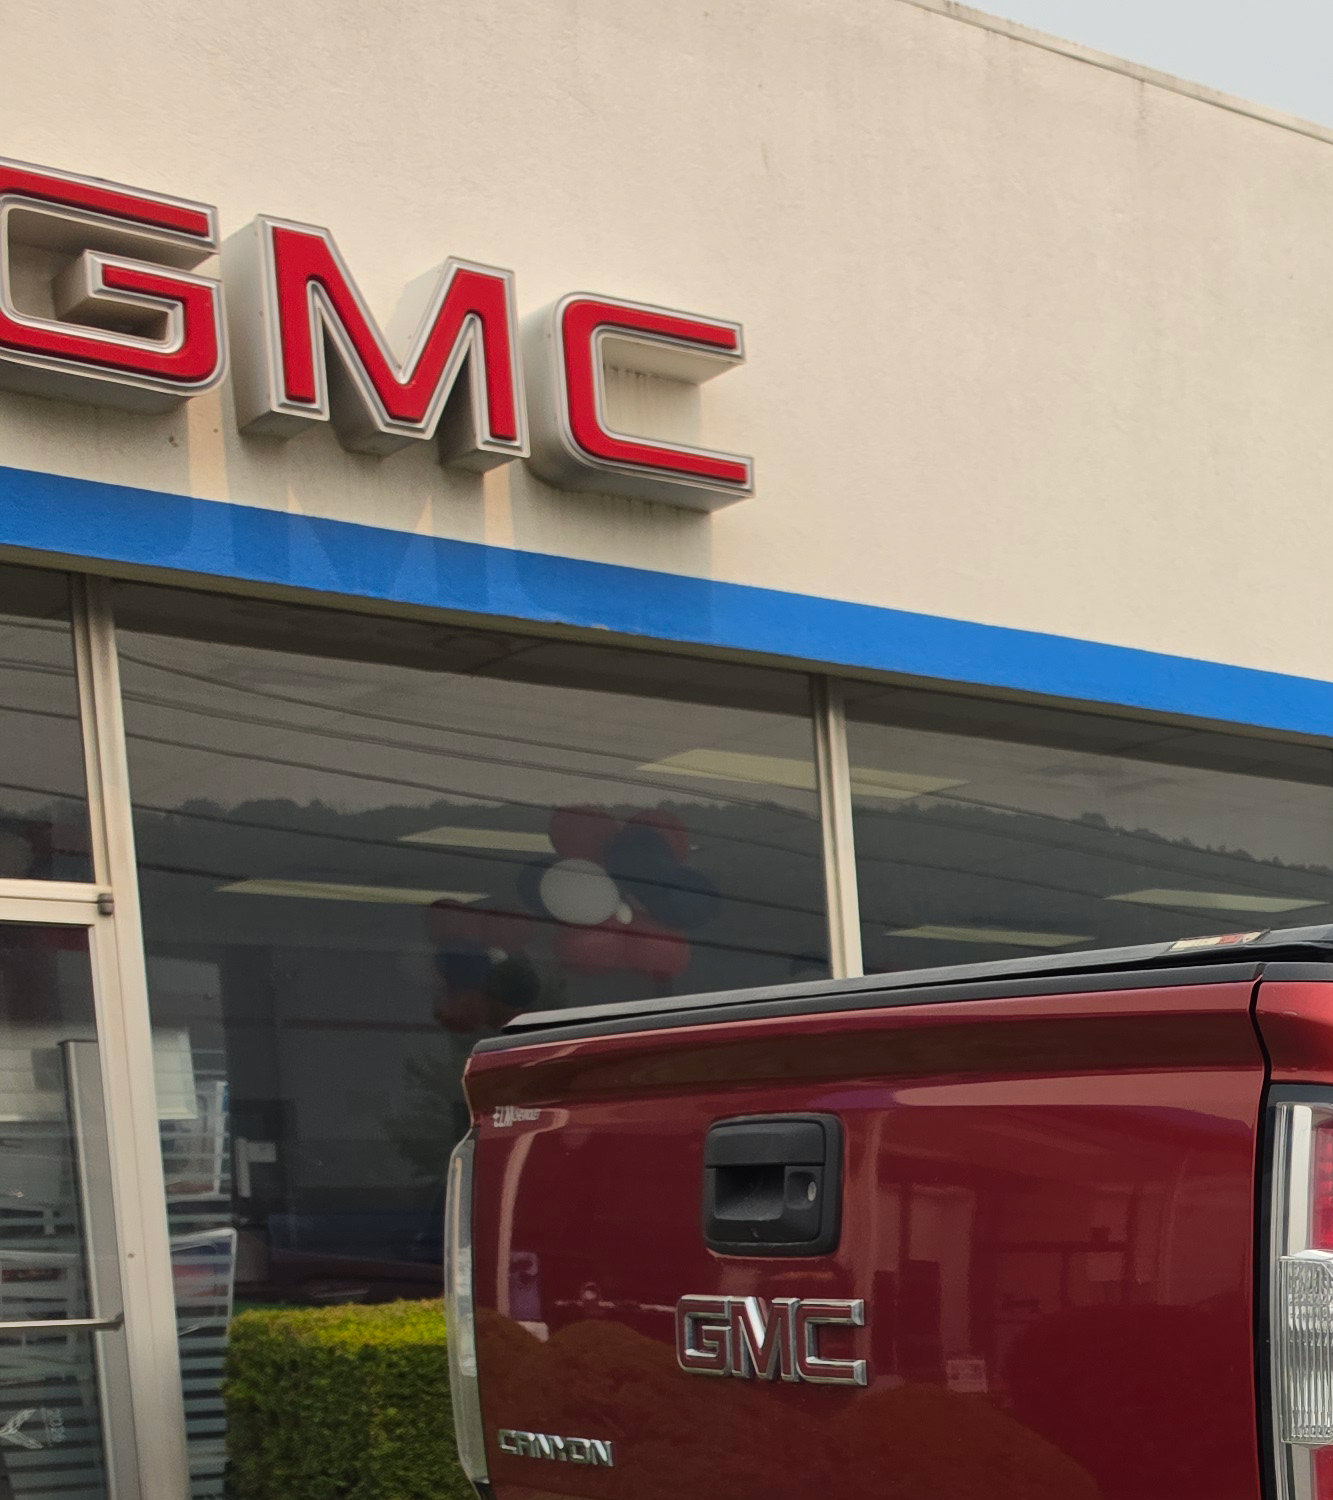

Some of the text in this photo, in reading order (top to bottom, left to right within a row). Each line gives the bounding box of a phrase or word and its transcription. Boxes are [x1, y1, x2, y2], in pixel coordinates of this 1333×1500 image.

[0, 157, 757, 508] GMC
[675, 1294, 868, 1386] GMC
[498, 1428, 614, 1468] CANYON
